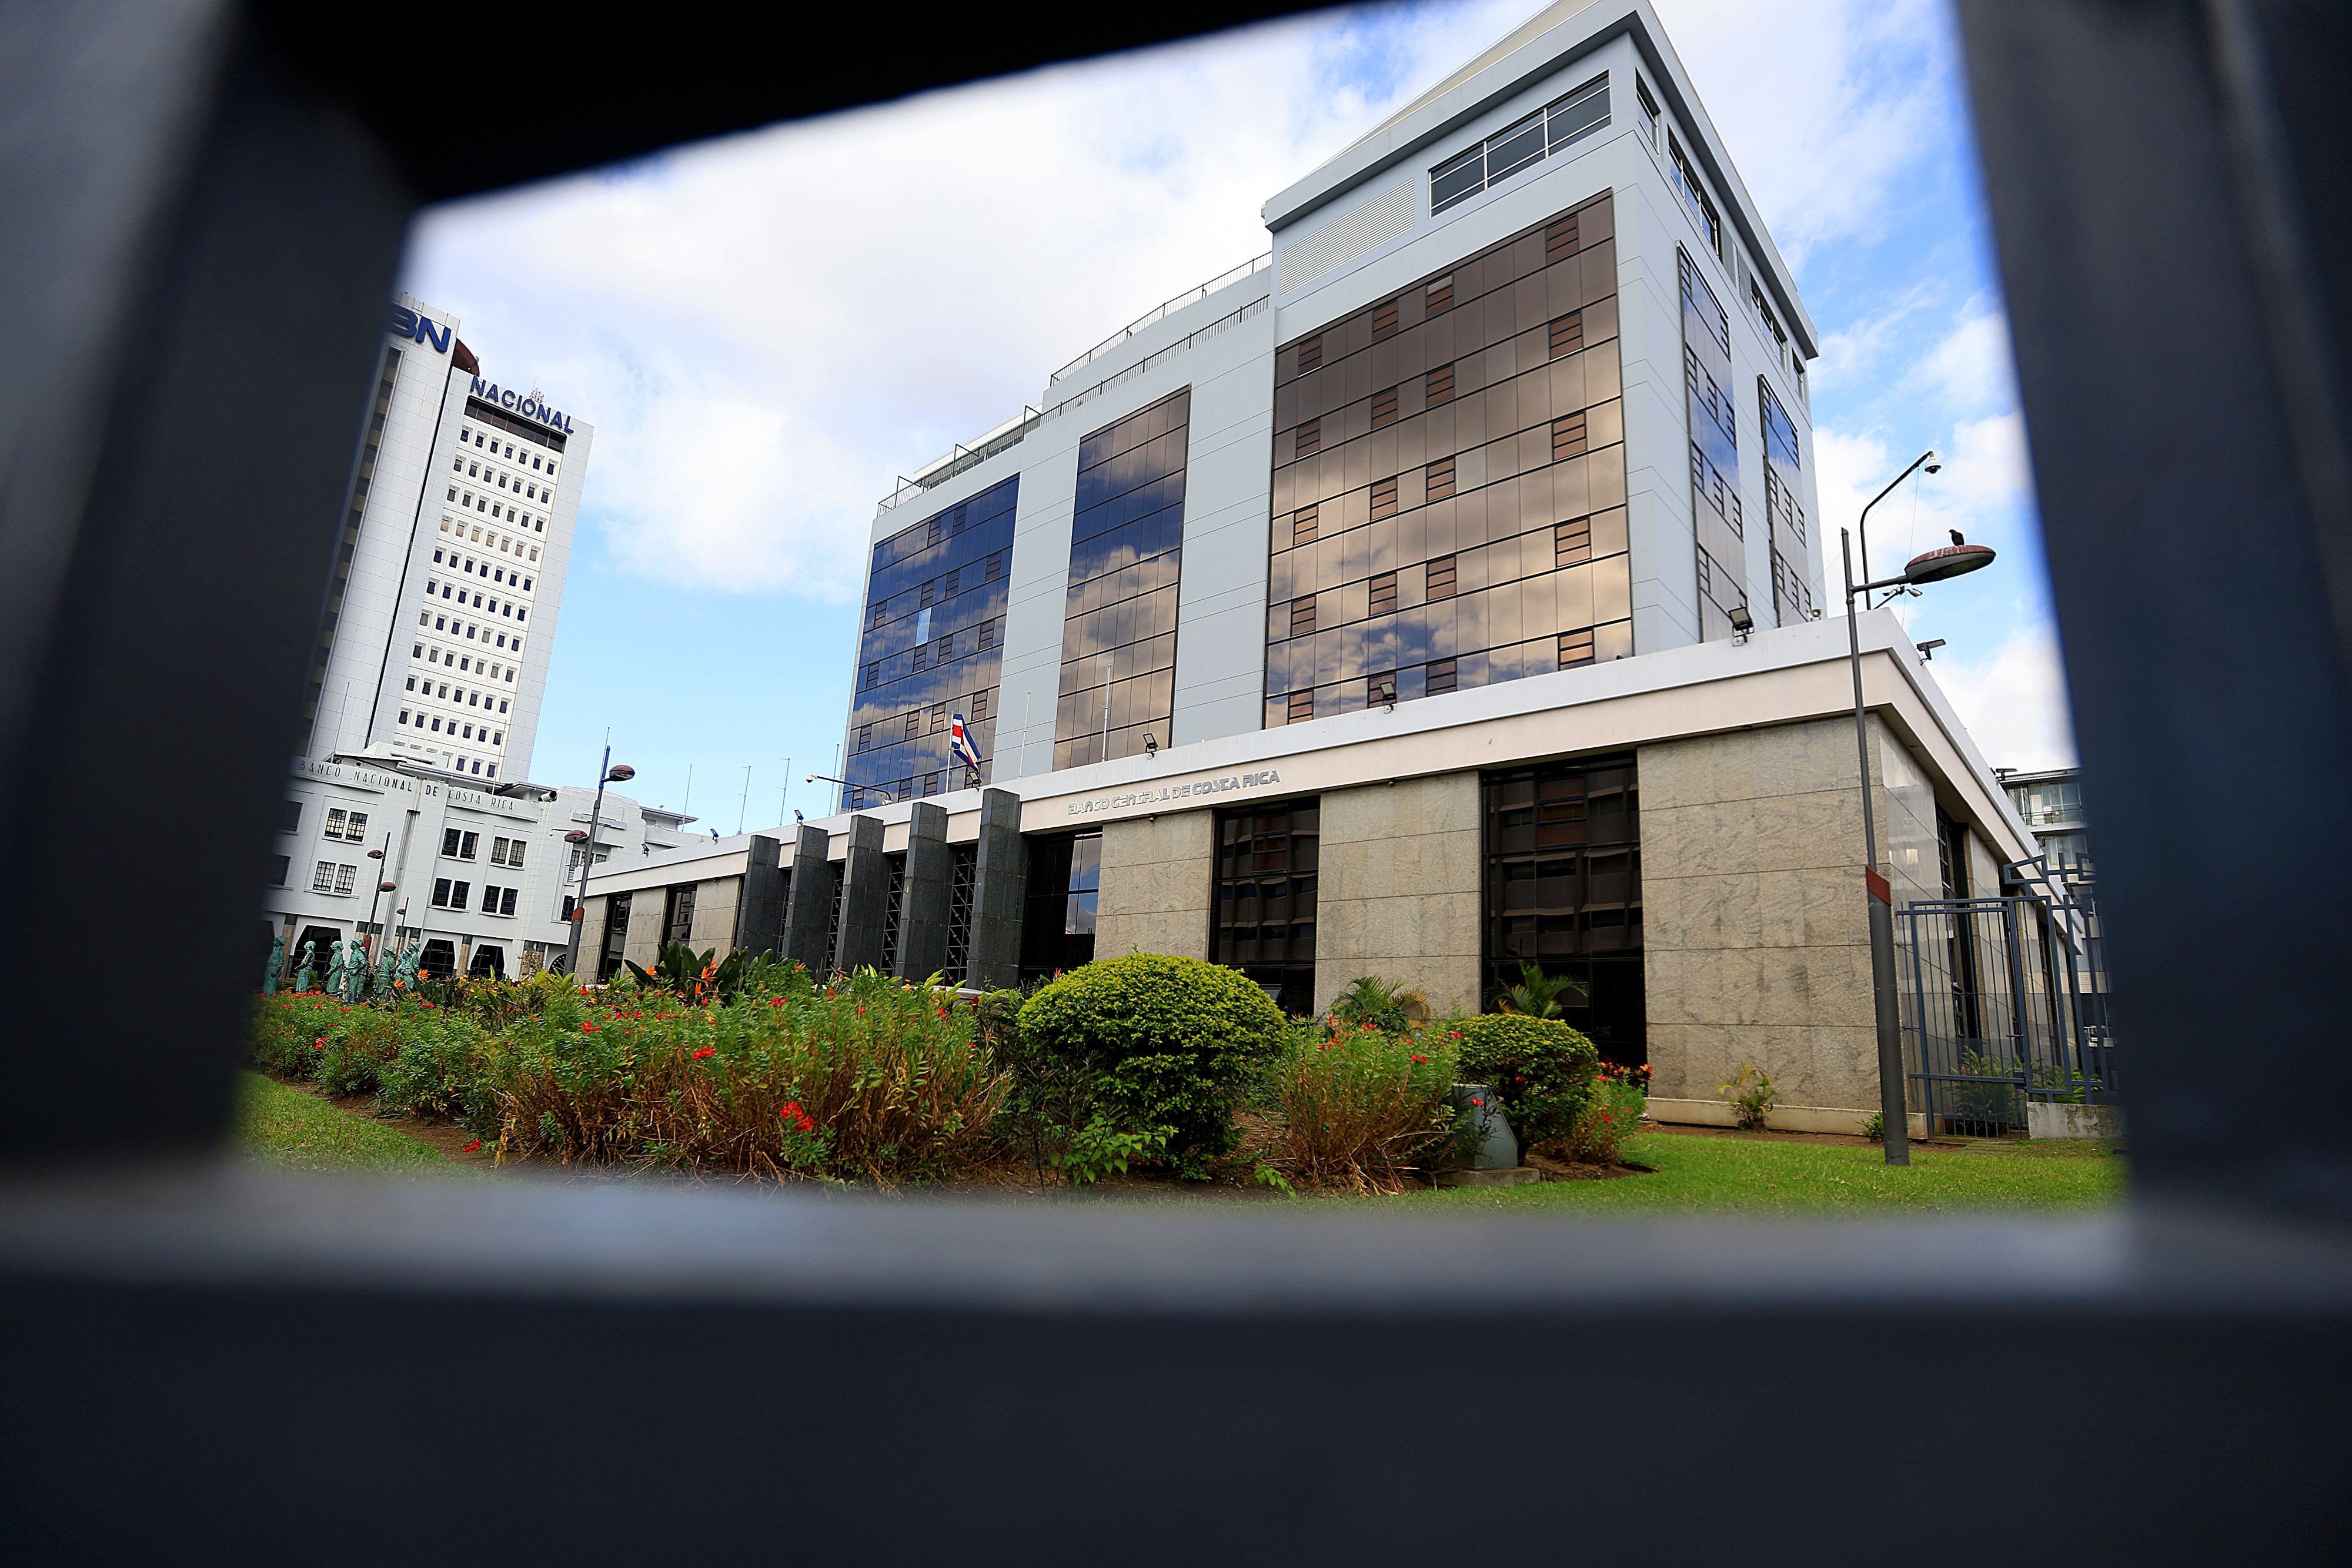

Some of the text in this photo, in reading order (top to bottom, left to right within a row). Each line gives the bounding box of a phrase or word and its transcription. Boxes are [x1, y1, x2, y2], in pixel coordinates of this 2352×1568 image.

[390, 305, 451, 352] BN
[471, 376, 574, 433] NACIONAL
[299, 760, 513, 810] BANCO NACIONAL DE COSTA RICA
[1068, 770, 1281, 815] BANCO CENTRAL DE COSTA RICA
